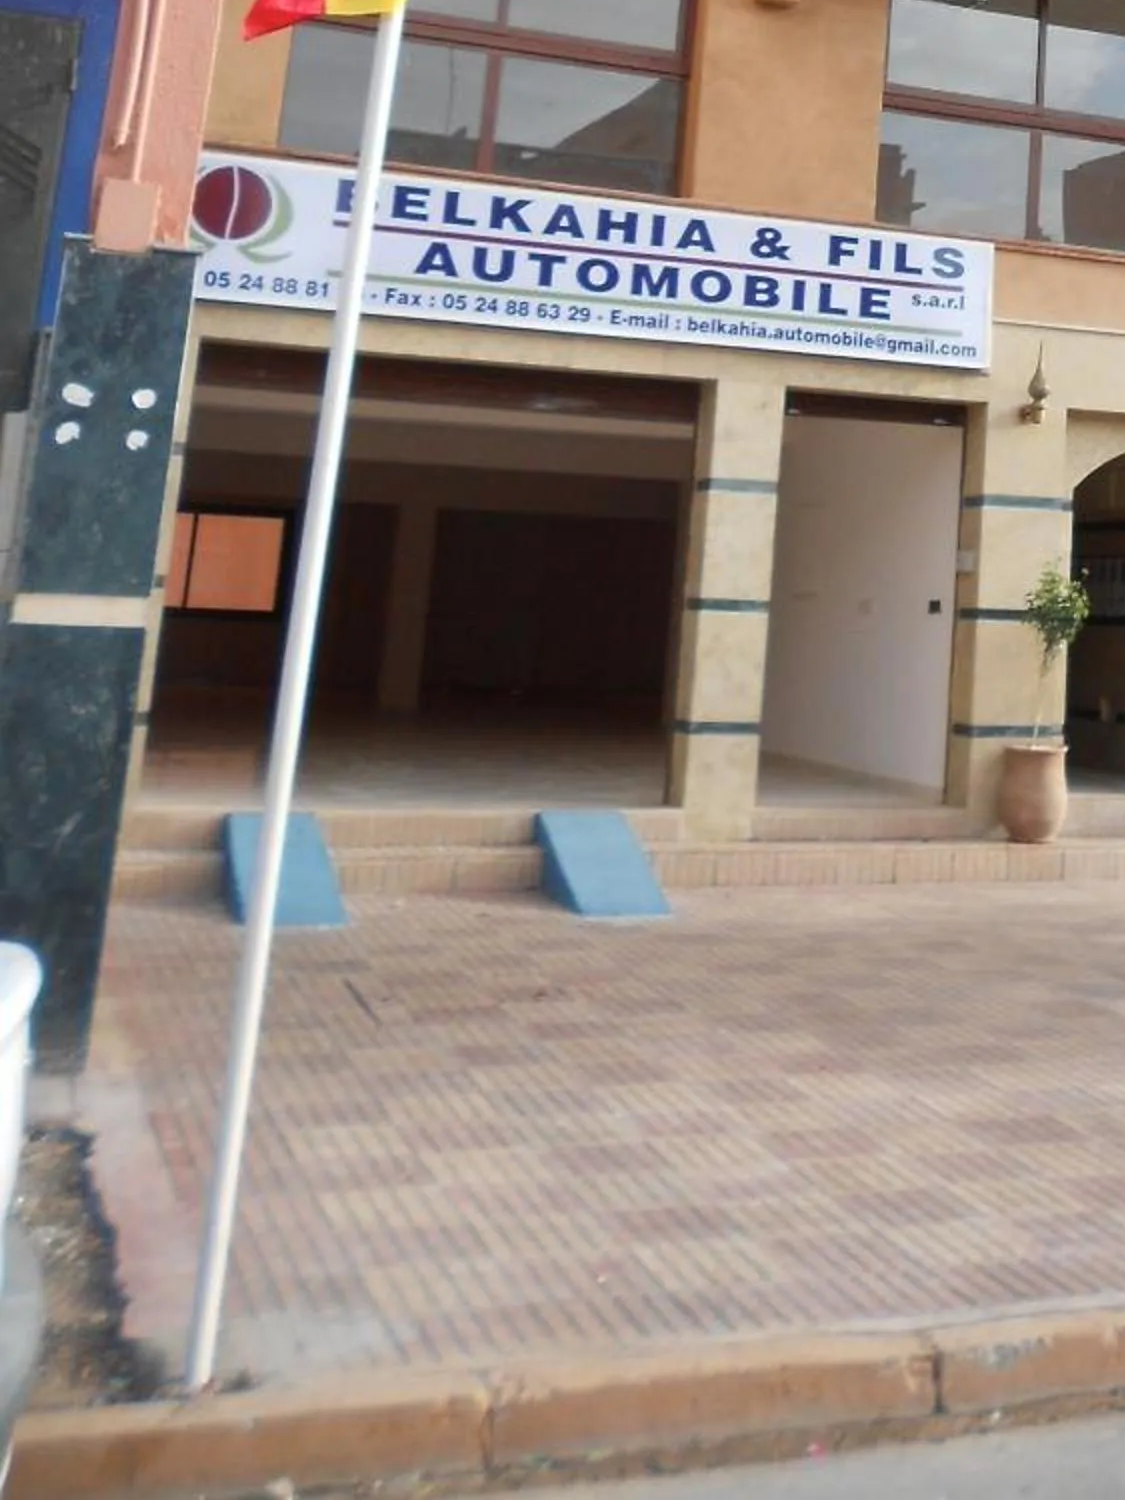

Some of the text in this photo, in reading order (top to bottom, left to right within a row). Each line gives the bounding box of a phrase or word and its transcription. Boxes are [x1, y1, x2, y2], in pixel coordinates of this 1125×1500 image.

[414, 241, 892, 321] AUTOMOBILE
[749, 227, 791, 262] &
[827, 234, 966, 279] FILS
[204, 270, 231, 289] 05
[239, 273, 264, 293] 24
[272, 276, 298, 296] 88
[305, 280, 329, 299] 81
[384, 287, 423, 307] Fax
[442, 293, 467, 311] 05
[474, 297, 498, 314] 24
[505, 300, 530, 318] 88
[537, 302, 560, 320] 63
[568, 305, 592, 323] 29
[609, 309, 671, 331] E-mail
